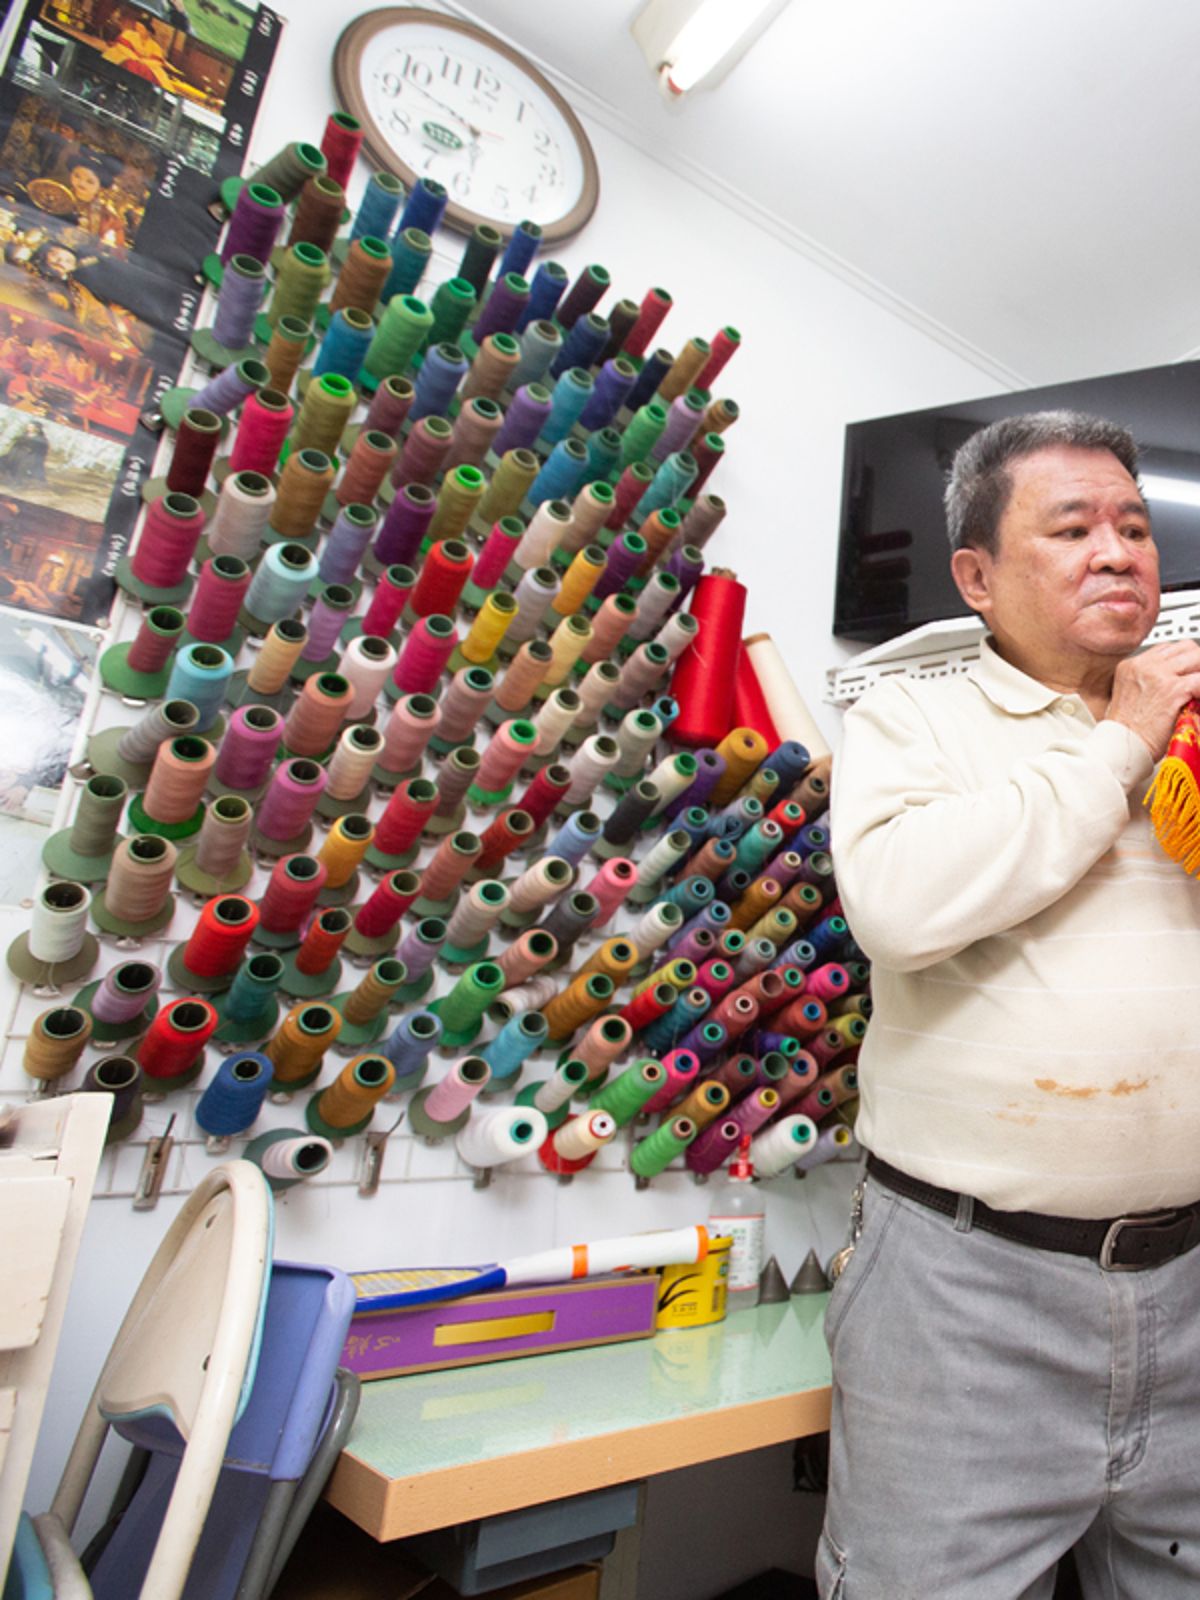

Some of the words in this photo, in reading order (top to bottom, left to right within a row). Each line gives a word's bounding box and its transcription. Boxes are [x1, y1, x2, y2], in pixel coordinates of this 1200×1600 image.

[403, 54, 432, 86] 10
[441, 56, 463, 85] 11
[382, 72, 402, 97] 9
[474, 68, 501, 101] 12
[390, 109, 411, 135] 8
[516, 101, 525, 122] 1
[423, 142, 439, 169] 7
[534, 130, 550, 156] 2
[453, 171, 470, 196] 6
[538, 163, 556, 187] 3
[494, 184, 510, 209] 5
[522, 185, 536, 203] 4
